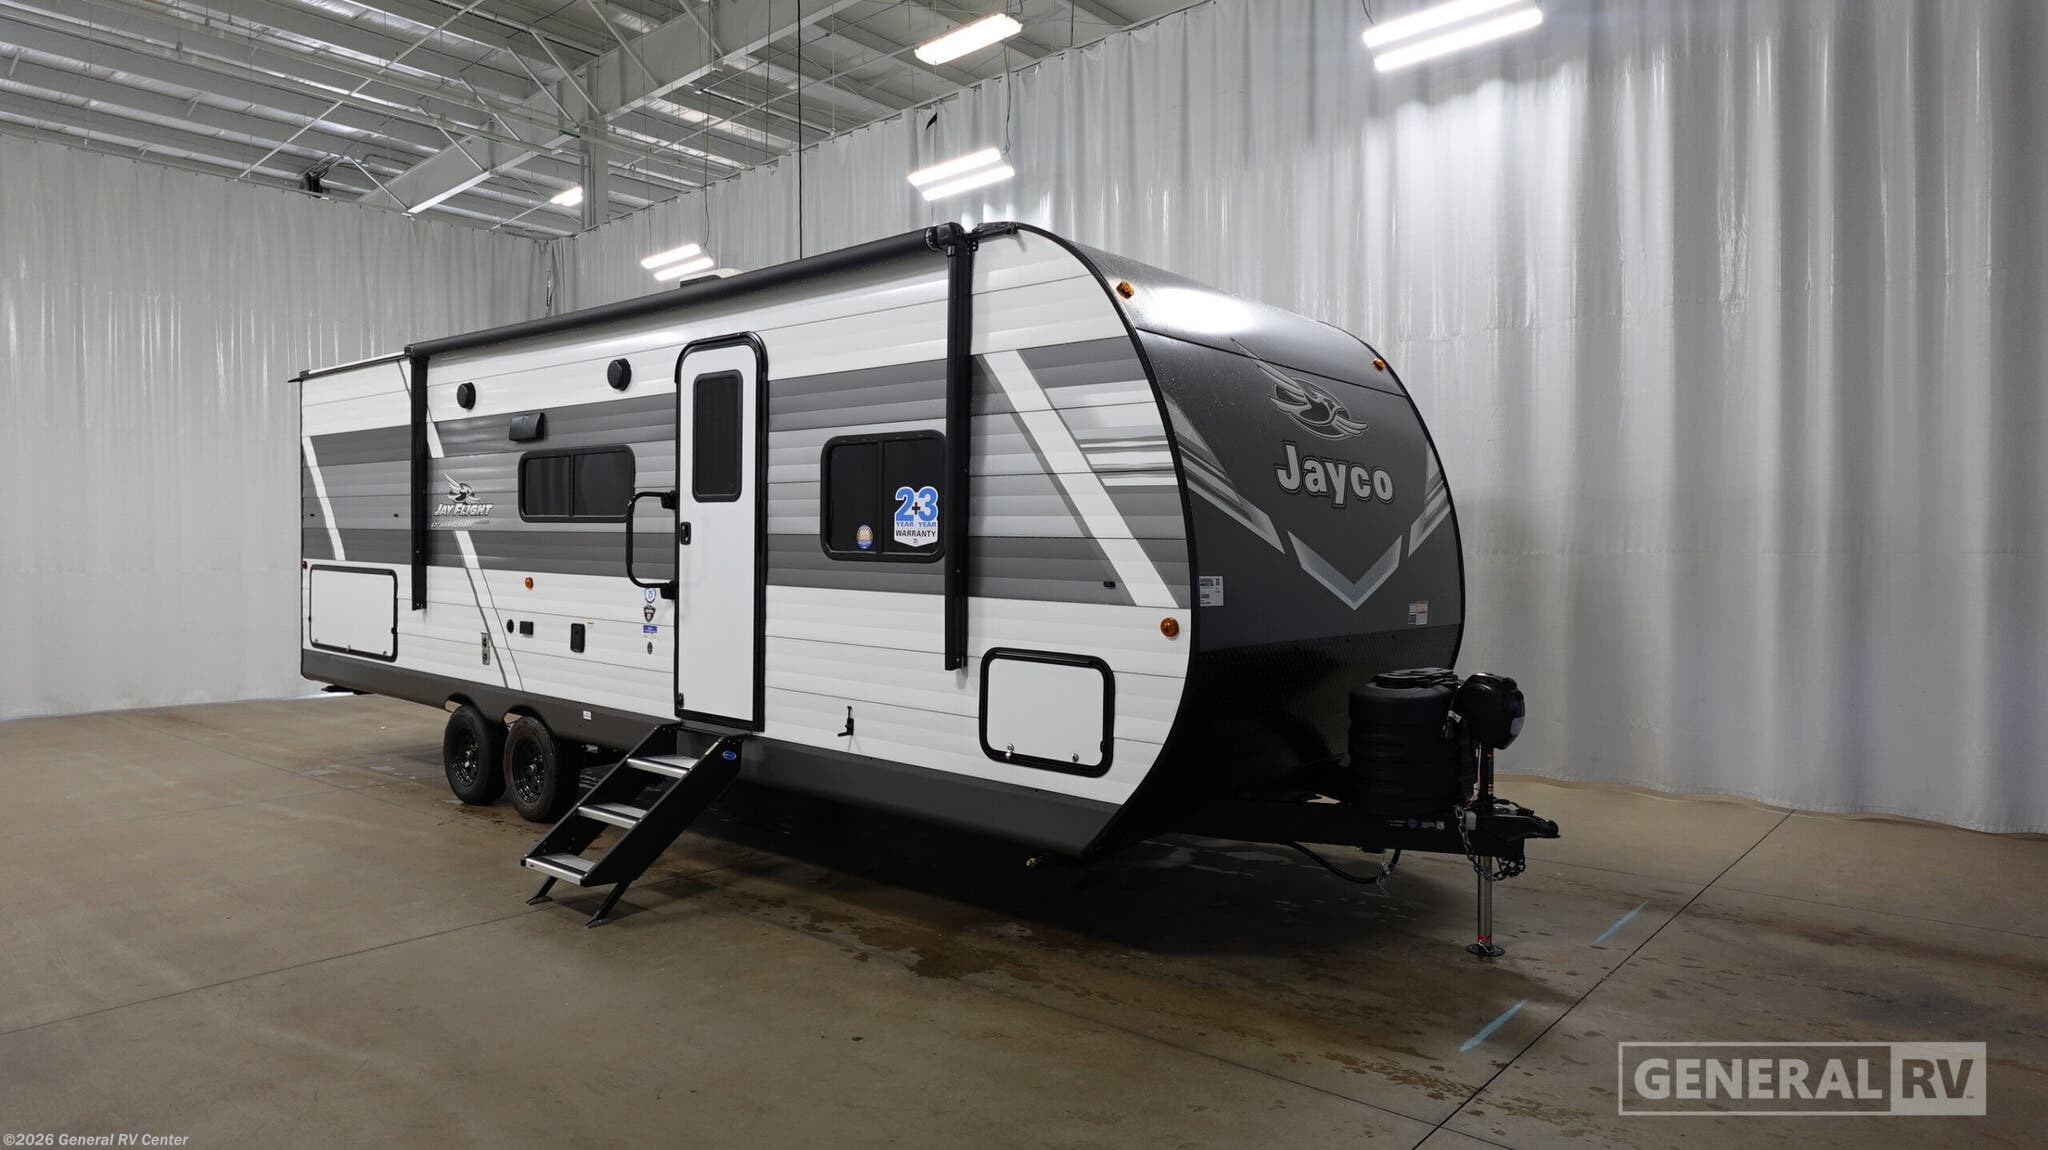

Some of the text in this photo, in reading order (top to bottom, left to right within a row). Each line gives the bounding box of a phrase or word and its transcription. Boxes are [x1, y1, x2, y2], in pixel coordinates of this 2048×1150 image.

[1275, 441, 1395, 507] Jayco
[434, 504, 493, 516] JAY FLIGHT
